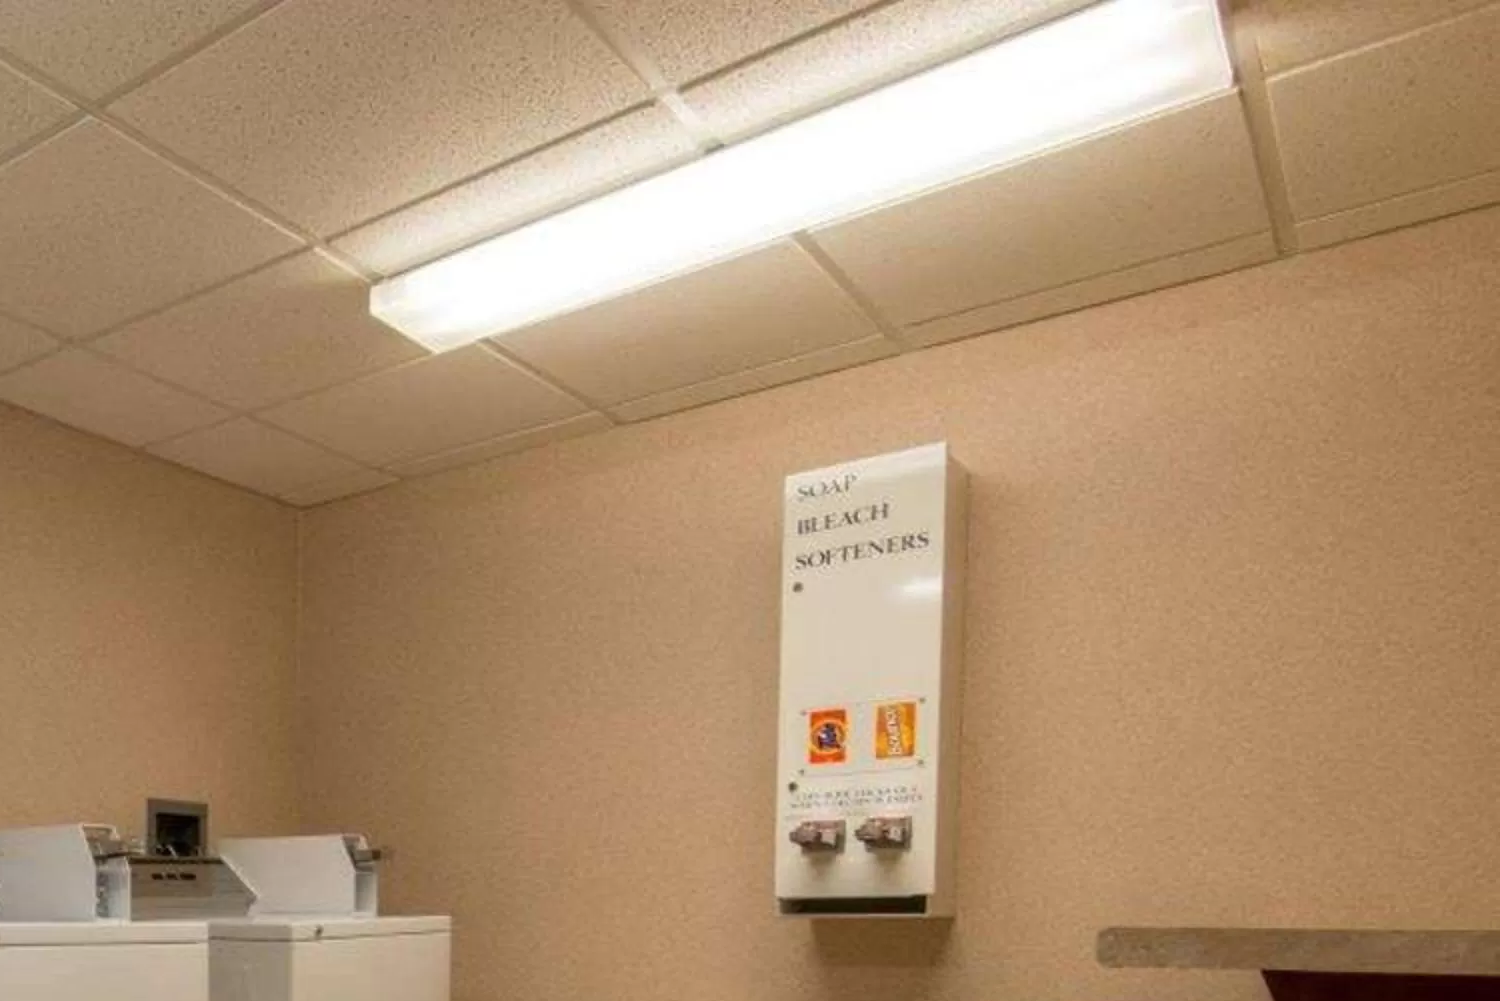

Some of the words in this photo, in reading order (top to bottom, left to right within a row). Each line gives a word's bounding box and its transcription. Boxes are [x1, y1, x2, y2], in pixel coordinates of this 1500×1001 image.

[797, 474, 857, 497] SOAP
[797, 502, 890, 535] BLEACH
[795, 531, 930, 570] SOFTENERS
